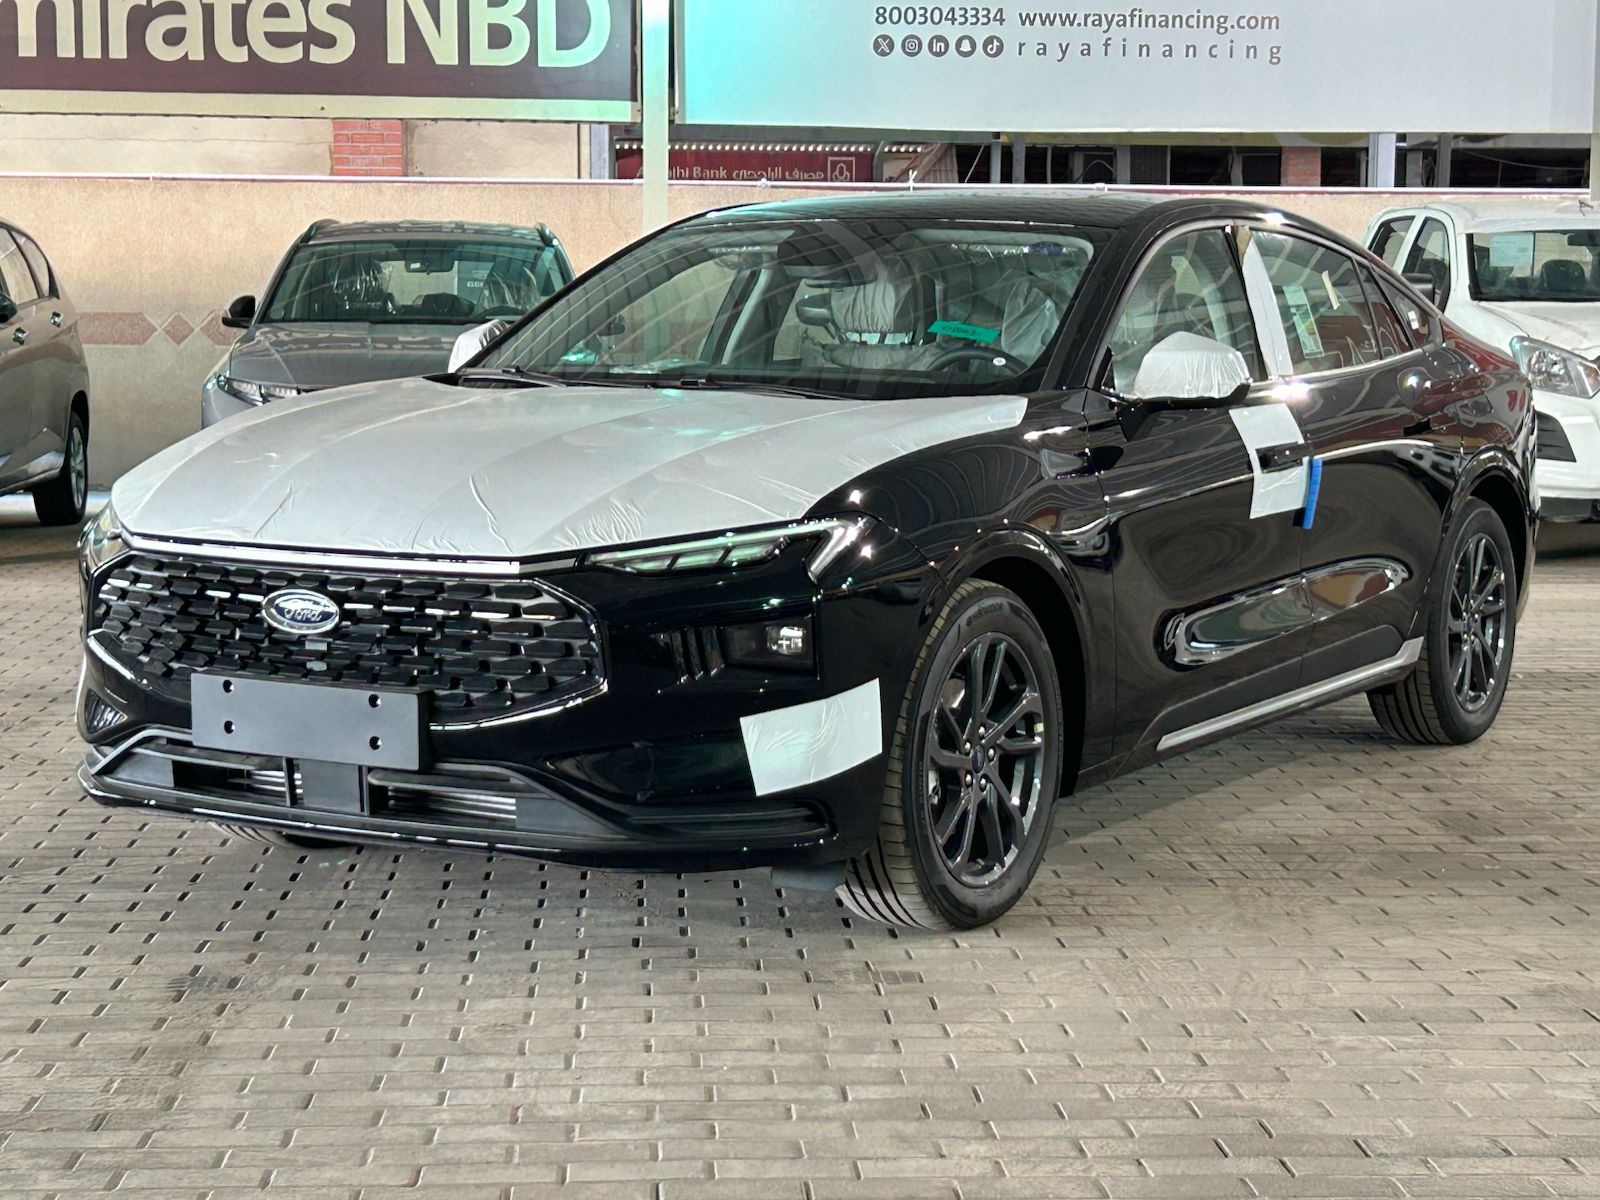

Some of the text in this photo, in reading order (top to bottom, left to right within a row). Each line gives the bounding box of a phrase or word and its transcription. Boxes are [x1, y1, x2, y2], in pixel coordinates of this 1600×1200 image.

[386, 0, 612, 68] NBD
[875, 6, 1280, 35] 8003043334 www.rayafinancing.com
[692, 165, 728, 180] Bank
